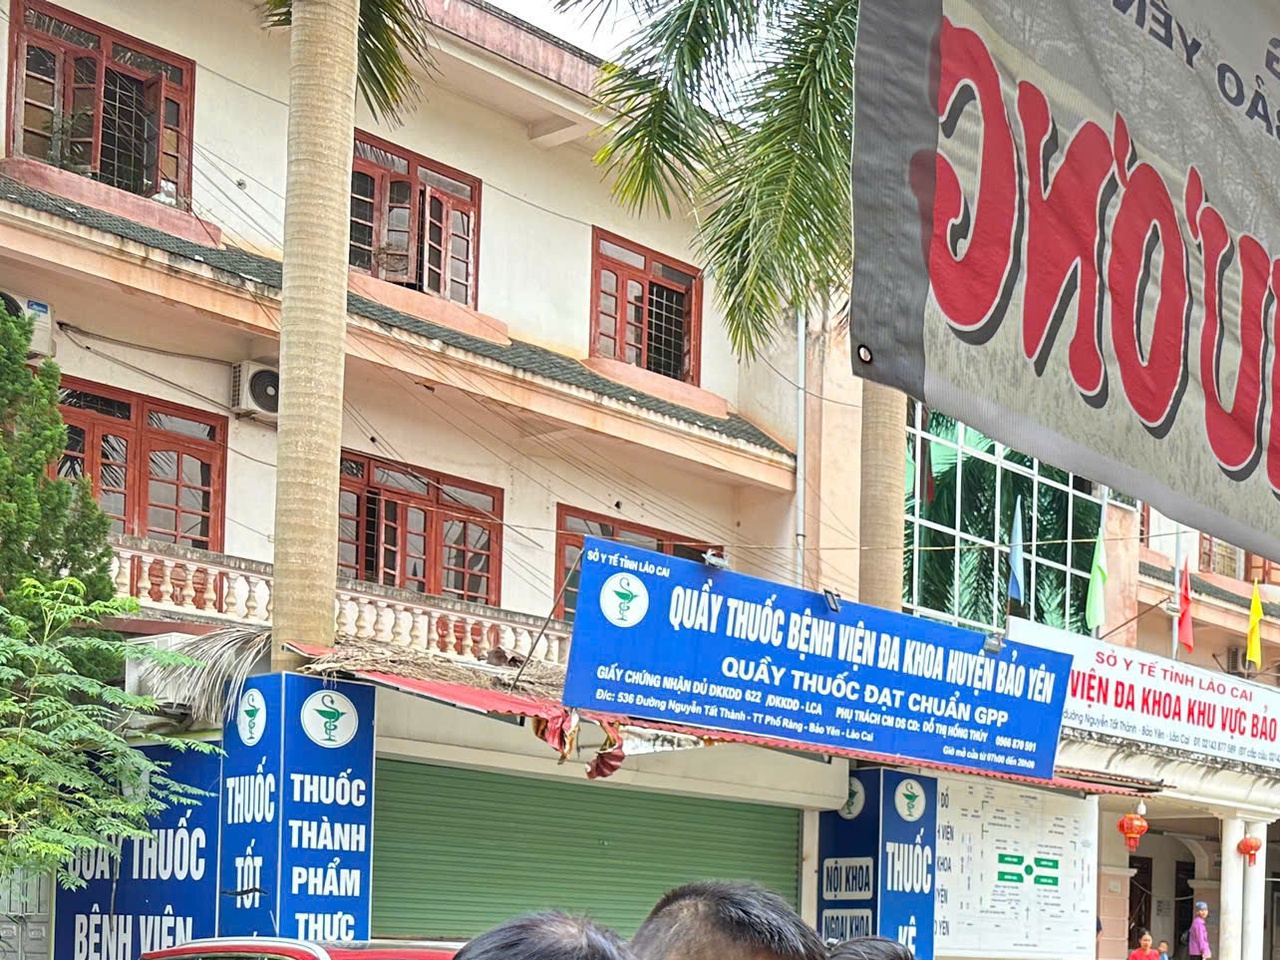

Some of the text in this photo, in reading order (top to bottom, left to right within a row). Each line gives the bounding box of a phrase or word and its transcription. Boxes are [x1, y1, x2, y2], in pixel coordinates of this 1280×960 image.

[600, 553, 607, 564] Y
[608, 553, 620, 567] TẾ
[656, 565, 670, 578] CAI
[669, 578, 1056, 704] QUẦY THUỐC BỆNH VIỆN ĐA KHOA HUYỆN BẢO YÊN
[597, 662, 624, 682] GIẤY
[624, 669, 662, 688] CHỨNG
[662, 675, 692, 695] NHẬN
[745, 689, 762, 703] 622
[805, 701, 822, 716] LCA
[836, 707, 854, 724] PHỤ
[854, 709, 881, 725] TRÁCH
[721, 655, 1009, 728] QUẦY THUỐC ĐẠT CHUẨN GPP
[1070, 668, 1109, 708] VIỆN
[1114, 681, 1136, 712] ĐA
[1141, 688, 1182, 722] KHOA
[1187, 697, 1216, 729] KHU
[1221, 706, 1247, 739] VỰC
[1251, 704, 1277, 743] BẢO
[1095, 650, 1253, 702] SỞ Y TẾ TỈNH LÀO CAI
[617, 691, 635, 704] 536
[635, 694, 666, 711] Đường
[668, 699, 702, 715] Nguyễn
[704, 705, 718, 718] Tất
[752, 712, 764, 724] TT
[860, 731, 874, 742] Cai
[226, 755, 276, 825] THUỐC
[290, 768, 366, 807] THUỐC
[131, 809, 206, 881] THUỐC
[288, 816, 366, 852] THÀNH
[886, 827, 932, 894] THUỐC
[235, 838, 263, 909] TỐT
[291, 857, 361, 897] PHẨM
[826, 860, 870, 898] NỘI KHOA
